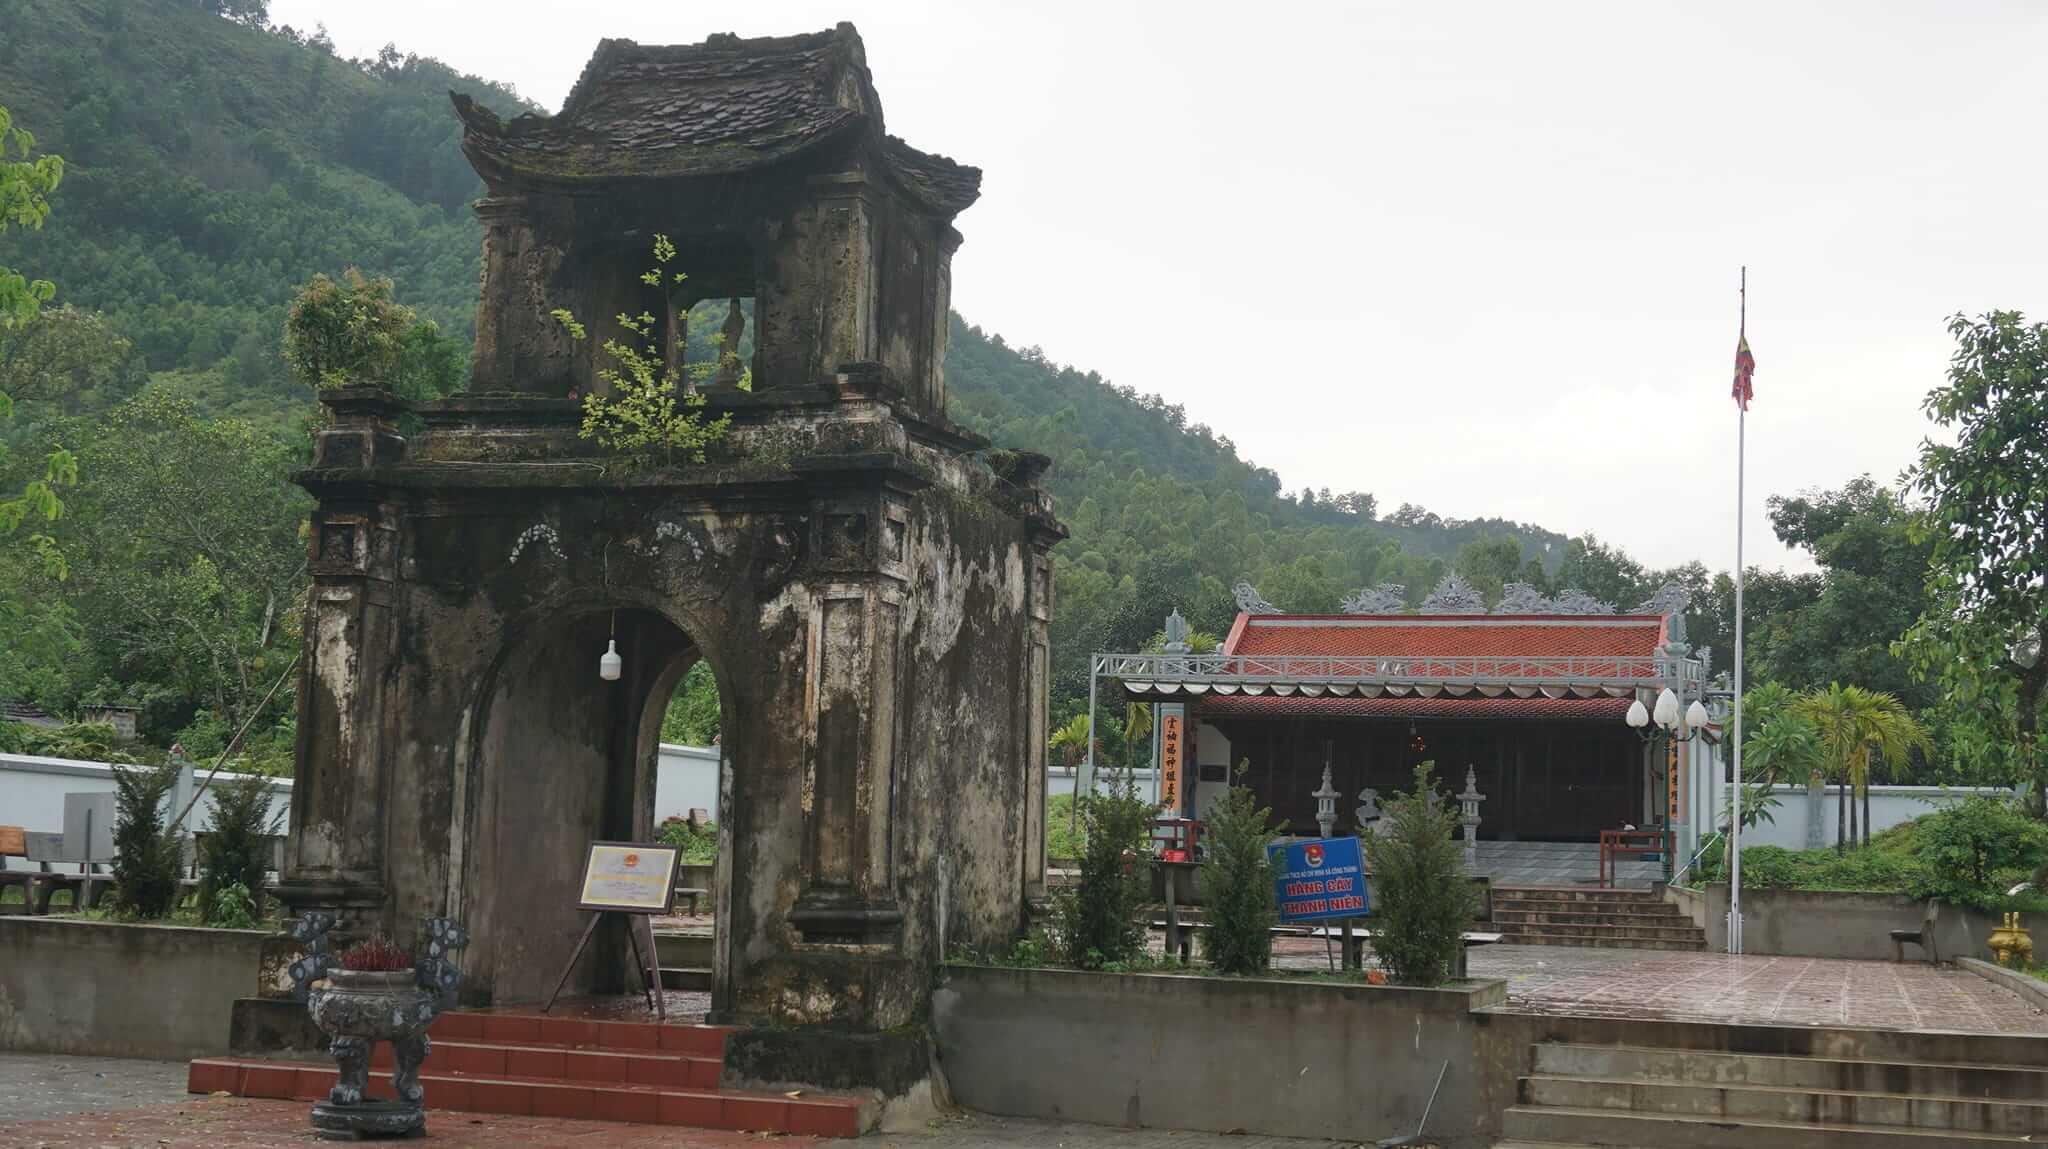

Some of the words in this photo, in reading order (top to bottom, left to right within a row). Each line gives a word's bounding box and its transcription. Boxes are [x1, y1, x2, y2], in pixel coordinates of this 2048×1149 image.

[1287, 880, 1324, 896] HÀNG
[1327, 877, 1353, 893] CÂY
[1283, 899, 1327, 914] THANH
[1329, 894, 1363, 911] NIÊN
